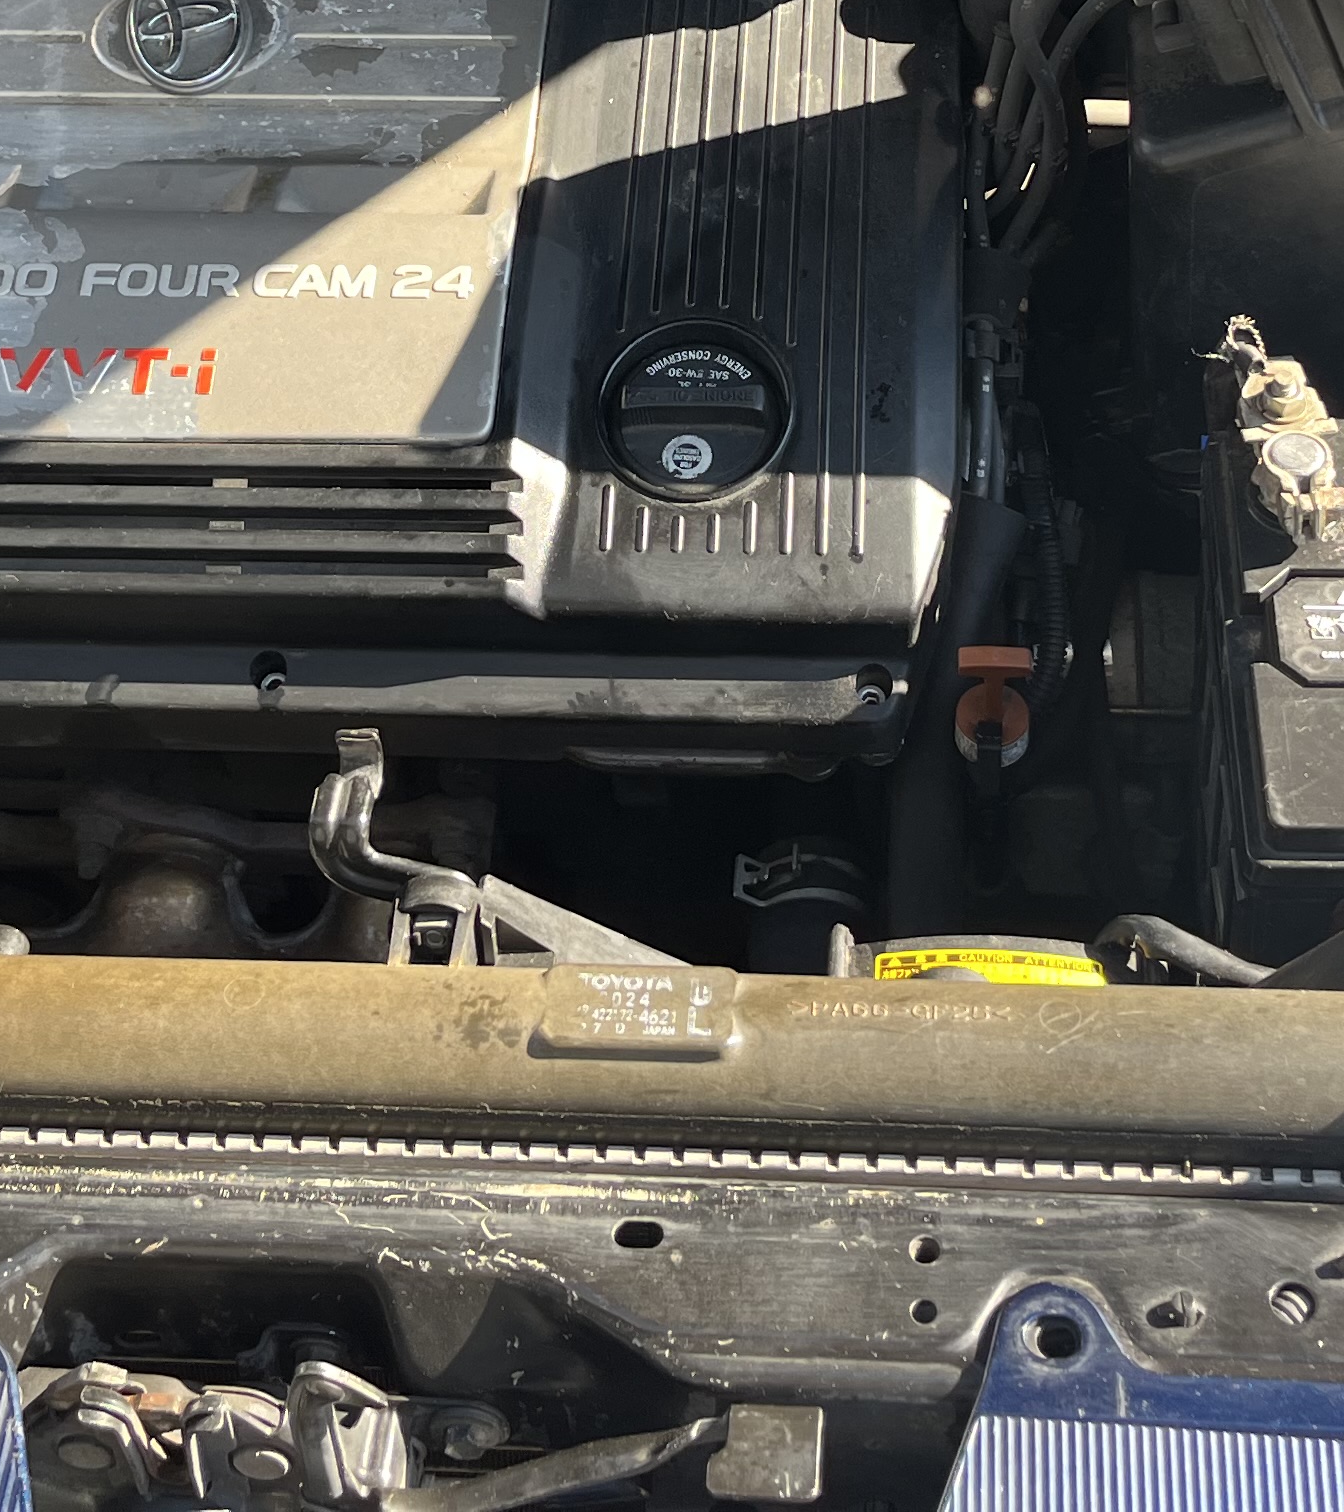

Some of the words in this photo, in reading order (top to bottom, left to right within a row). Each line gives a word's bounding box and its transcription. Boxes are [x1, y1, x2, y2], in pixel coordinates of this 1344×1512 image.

[78, 261, 240, 299] FOUR
[253, 263, 378, 300] CAM
[391, 263, 475, 300] 24
[0, 346, 219, 396] VVT-i
[645, 349, 712, 377] CONSERVING
[708, 369, 730, 381] SAE
[714, 353, 752, 381] ENERGY
[958, 954, 1013, 964] CAUTION
[577, 972, 673, 992] TOYOTA
[642, 1024, 676, 1036] JAPAN
[687, 1005, 712, 1036] L
